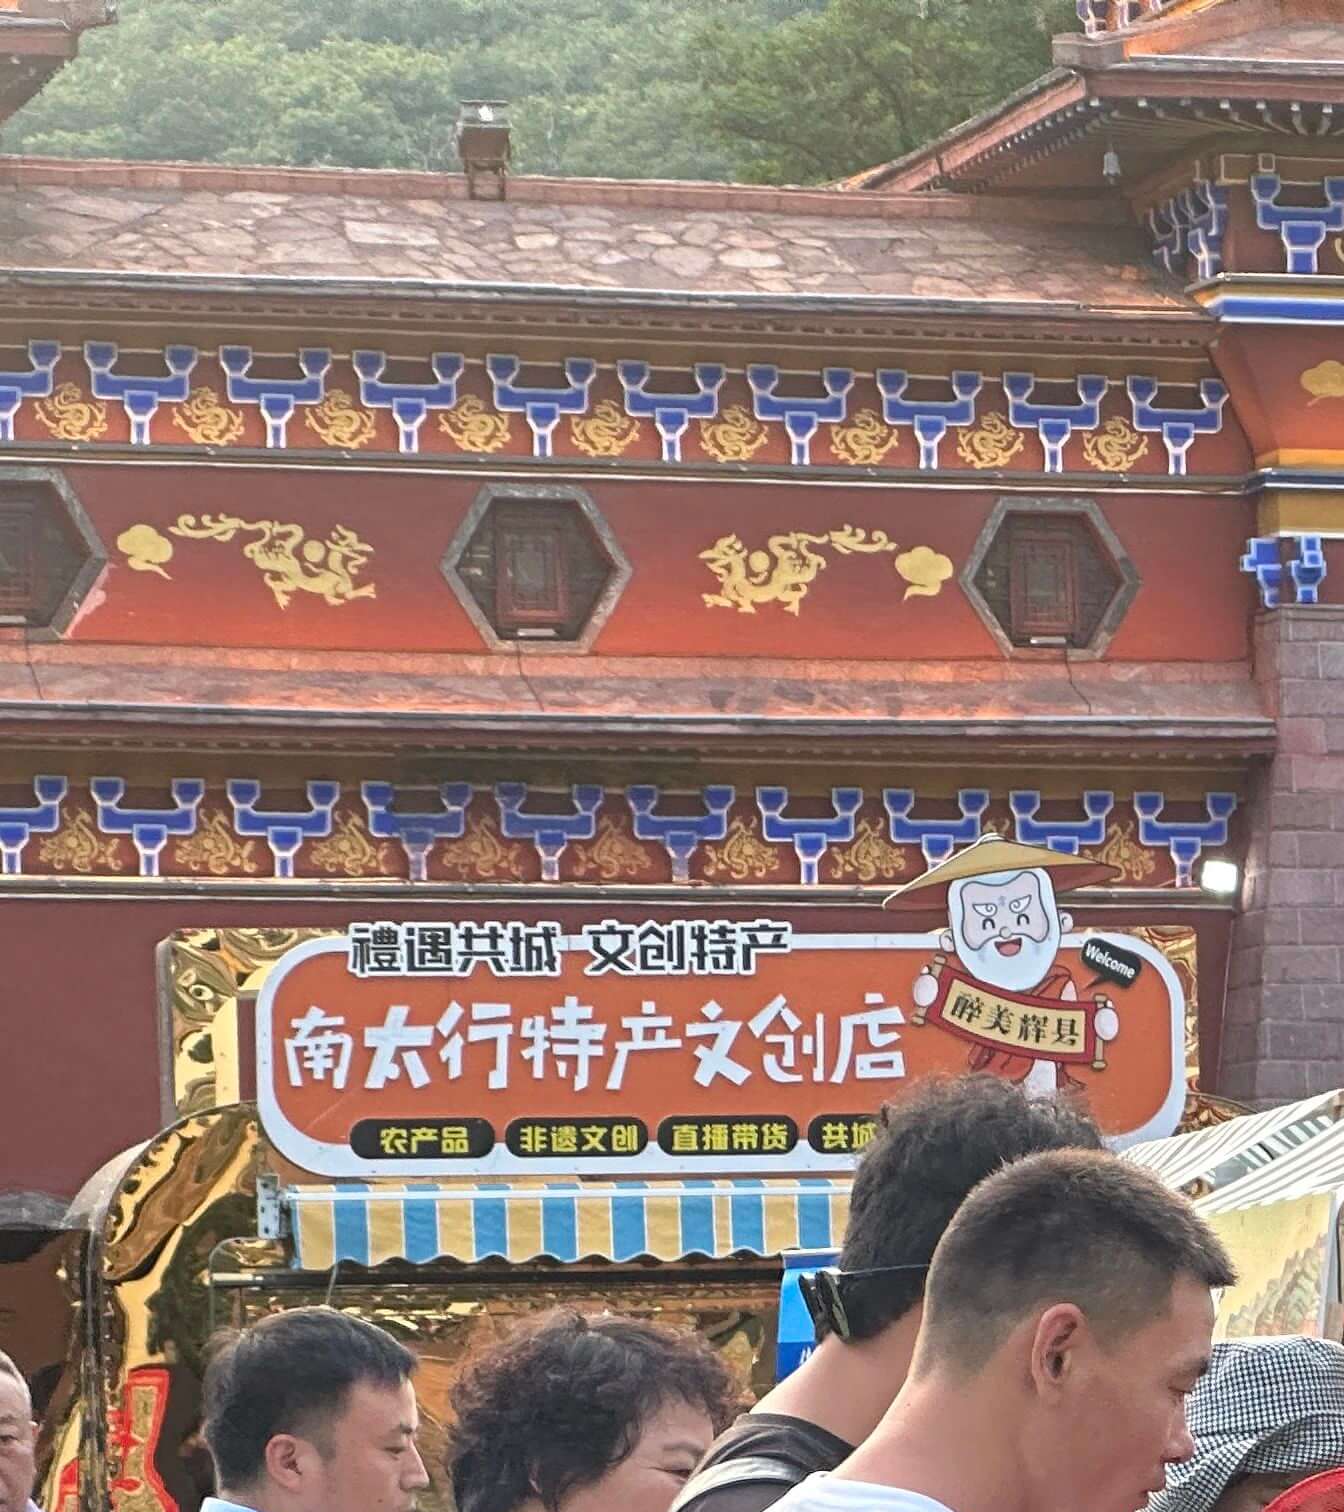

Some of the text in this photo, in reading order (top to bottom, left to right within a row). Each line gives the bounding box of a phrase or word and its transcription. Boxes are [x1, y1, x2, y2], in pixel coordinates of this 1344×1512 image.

[351, 925, 791, 973] 禮遇共城 文创特产
[1085, 943, 1136, 979] Welcome
[283, 993, 907, 1090] 南太行特产文创店
[380, 1126, 470, 1154] 农产品
[519, 1124, 639, 1153] 非遗文创
[671, 1122, 791, 1152] 直播带货
